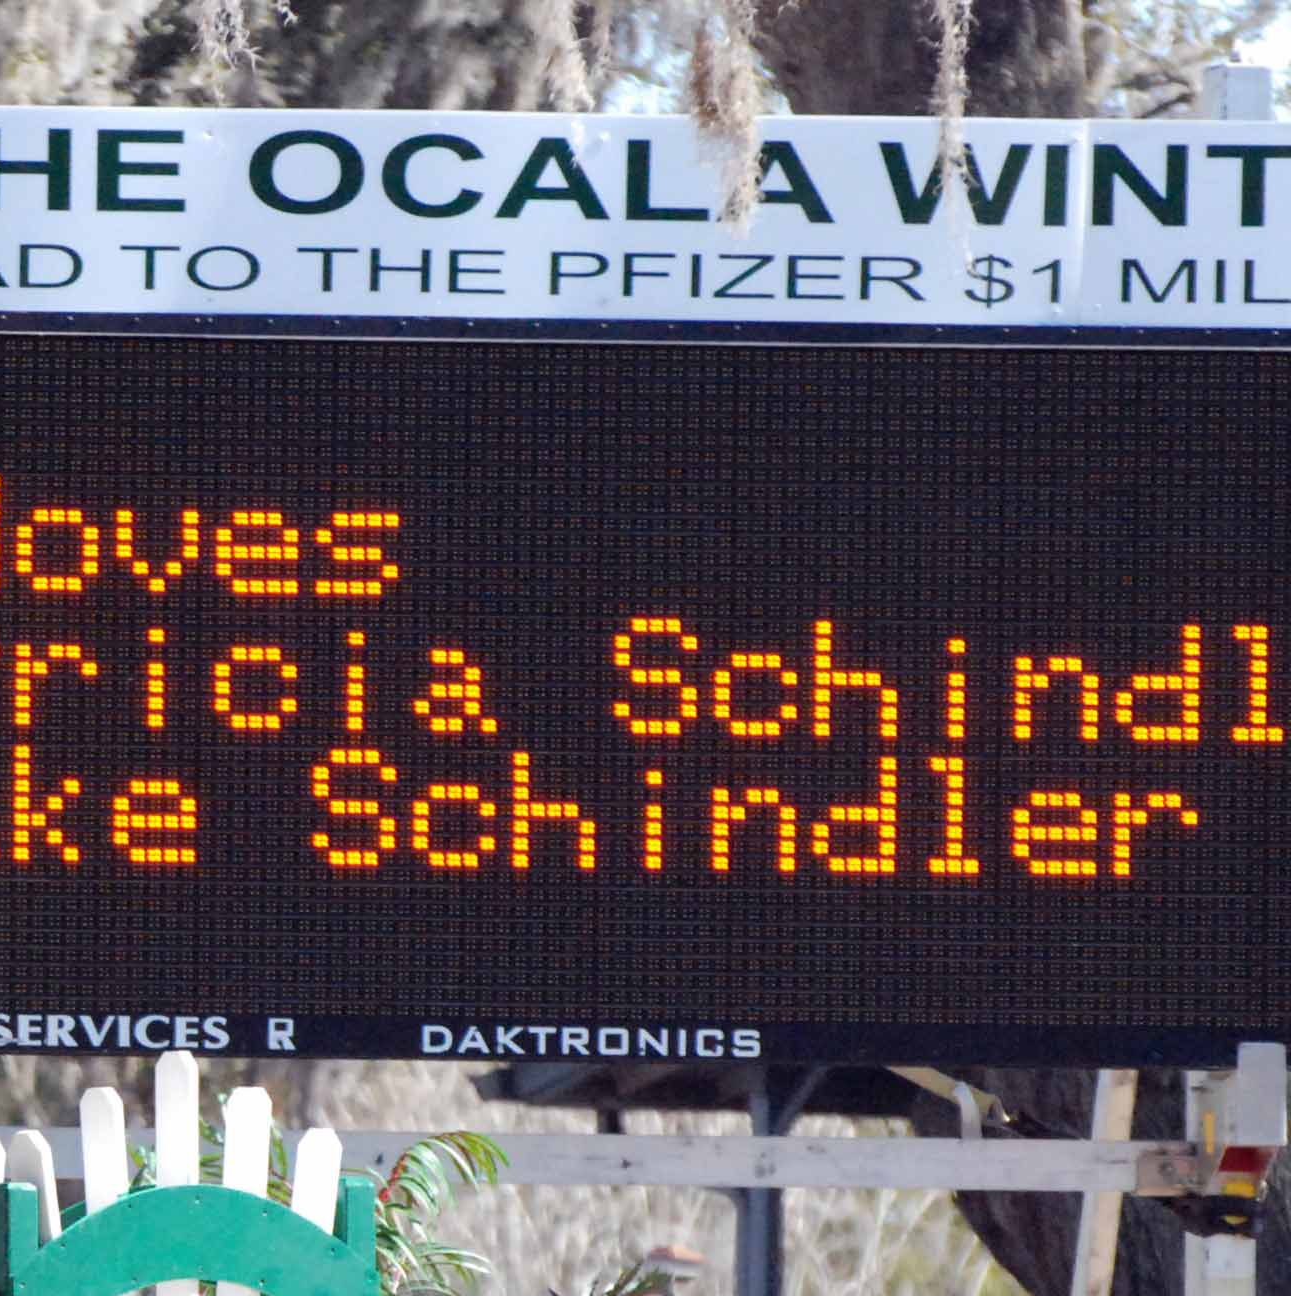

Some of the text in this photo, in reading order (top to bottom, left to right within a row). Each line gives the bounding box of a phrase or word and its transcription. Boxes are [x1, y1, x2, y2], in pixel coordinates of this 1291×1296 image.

[250, 131, 833, 221] OCALA
[880, 142, 1291, 226] WINT
[122, 246, 259, 290] TO
[298, 248, 504, 293] THE
[551, 252, 923, 300] PFIZER
[966, 256, 1059, 306] $1
[1122, 260, 1291, 303] MIL
[614, 618, 1283, 741] Schindl
[313, 747, 1199, 875] Schindler
[423, 1026, 760, 1058] DAKTRONICS
